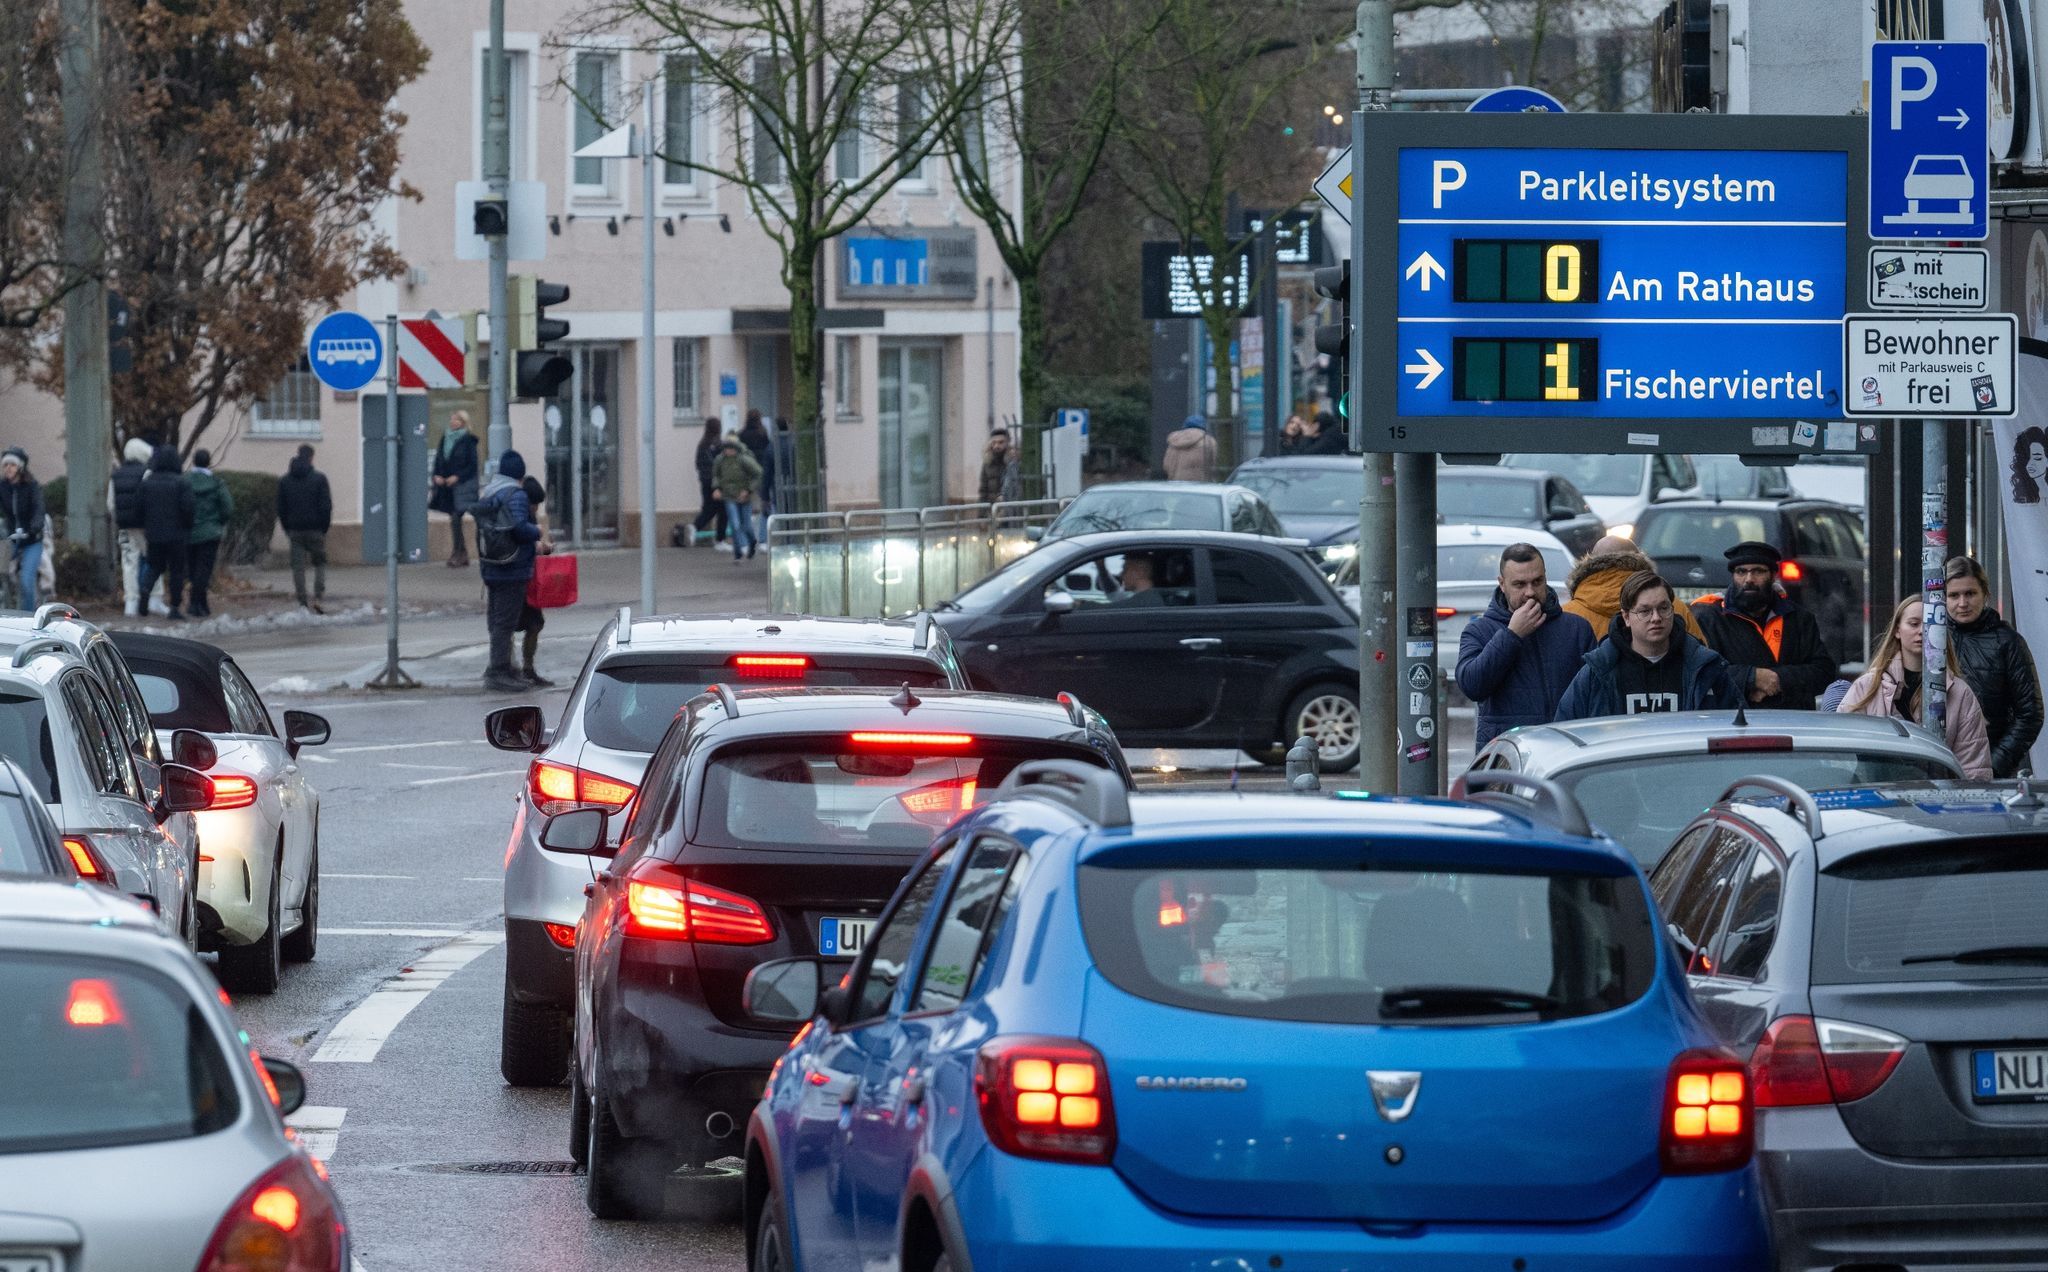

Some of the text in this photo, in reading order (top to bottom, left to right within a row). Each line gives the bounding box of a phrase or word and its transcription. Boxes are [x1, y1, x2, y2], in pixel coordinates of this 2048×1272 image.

[1890, 56, 1938, 130] P
[1433, 160, 1467, 208] P
[1519, 170, 1775, 209] Parkleitsystem
[1545, 244, 1581, 301] 0
[1914, 258, 1943, 275] mit
[1606, 271, 1815, 302] Am Rathaus
[1864, 328, 2000, 355] Bewohner
[1545, 343, 1580, 400] 1
[1878, 361, 1985, 373] mit Parkausweis C
[1605, 369, 1824, 400] Fischerviertel
[1907, 378, 1950, 404] frei
[1388, 426, 1407, 439] 15
[1135, 1075, 1247, 1090] SANDERO
[1998, 1055, 2044, 1090] NU
